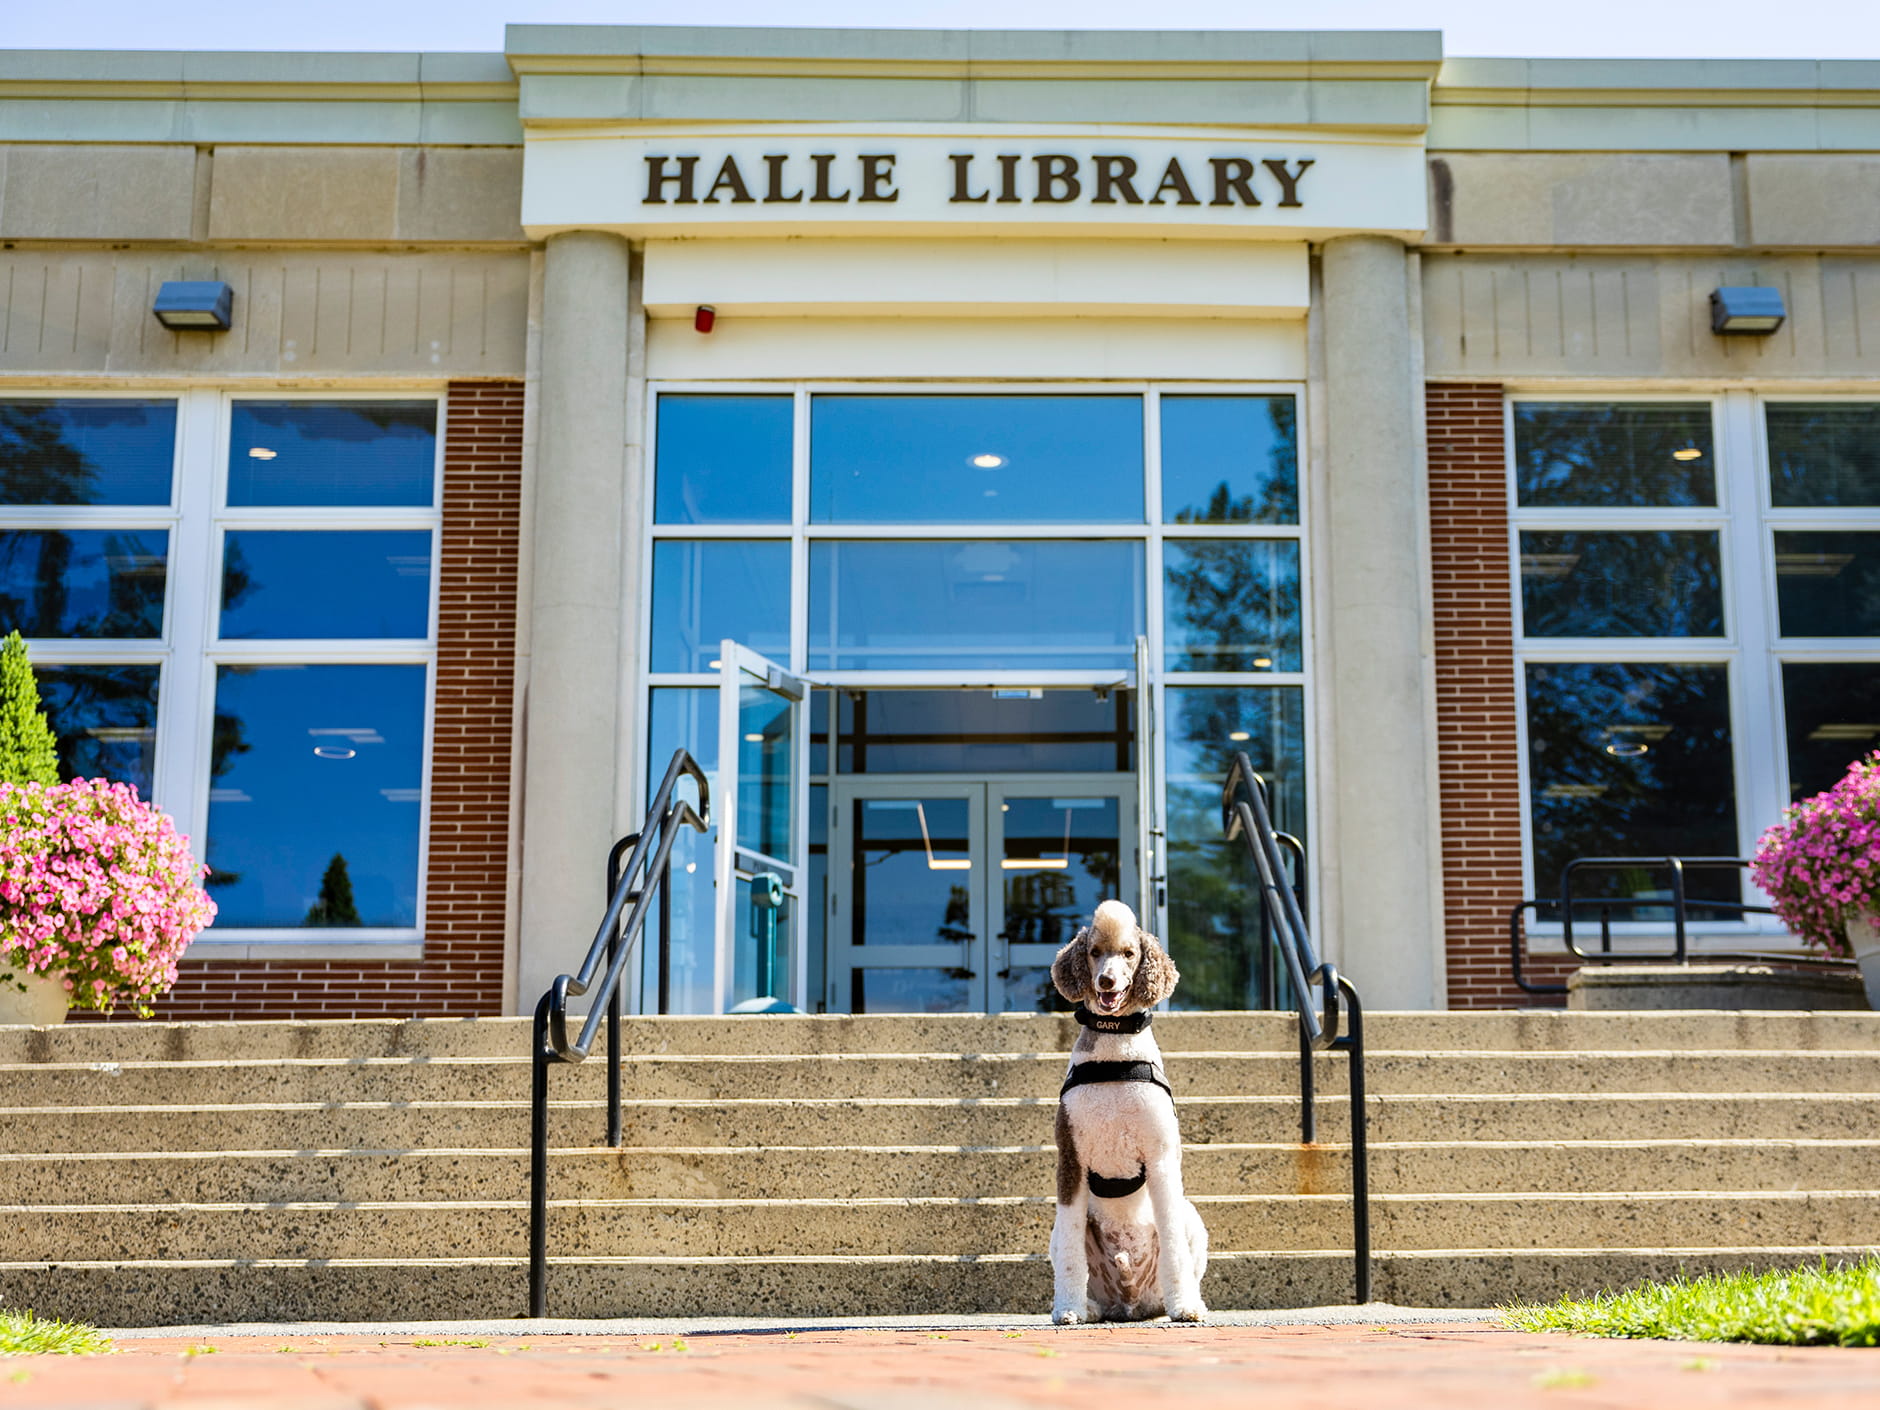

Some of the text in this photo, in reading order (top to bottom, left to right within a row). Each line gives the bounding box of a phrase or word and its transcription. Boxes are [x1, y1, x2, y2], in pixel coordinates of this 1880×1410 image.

[642, 154, 1315, 208] HALLE LIBRARY
[1096, 1020, 1121, 1030] GARY
